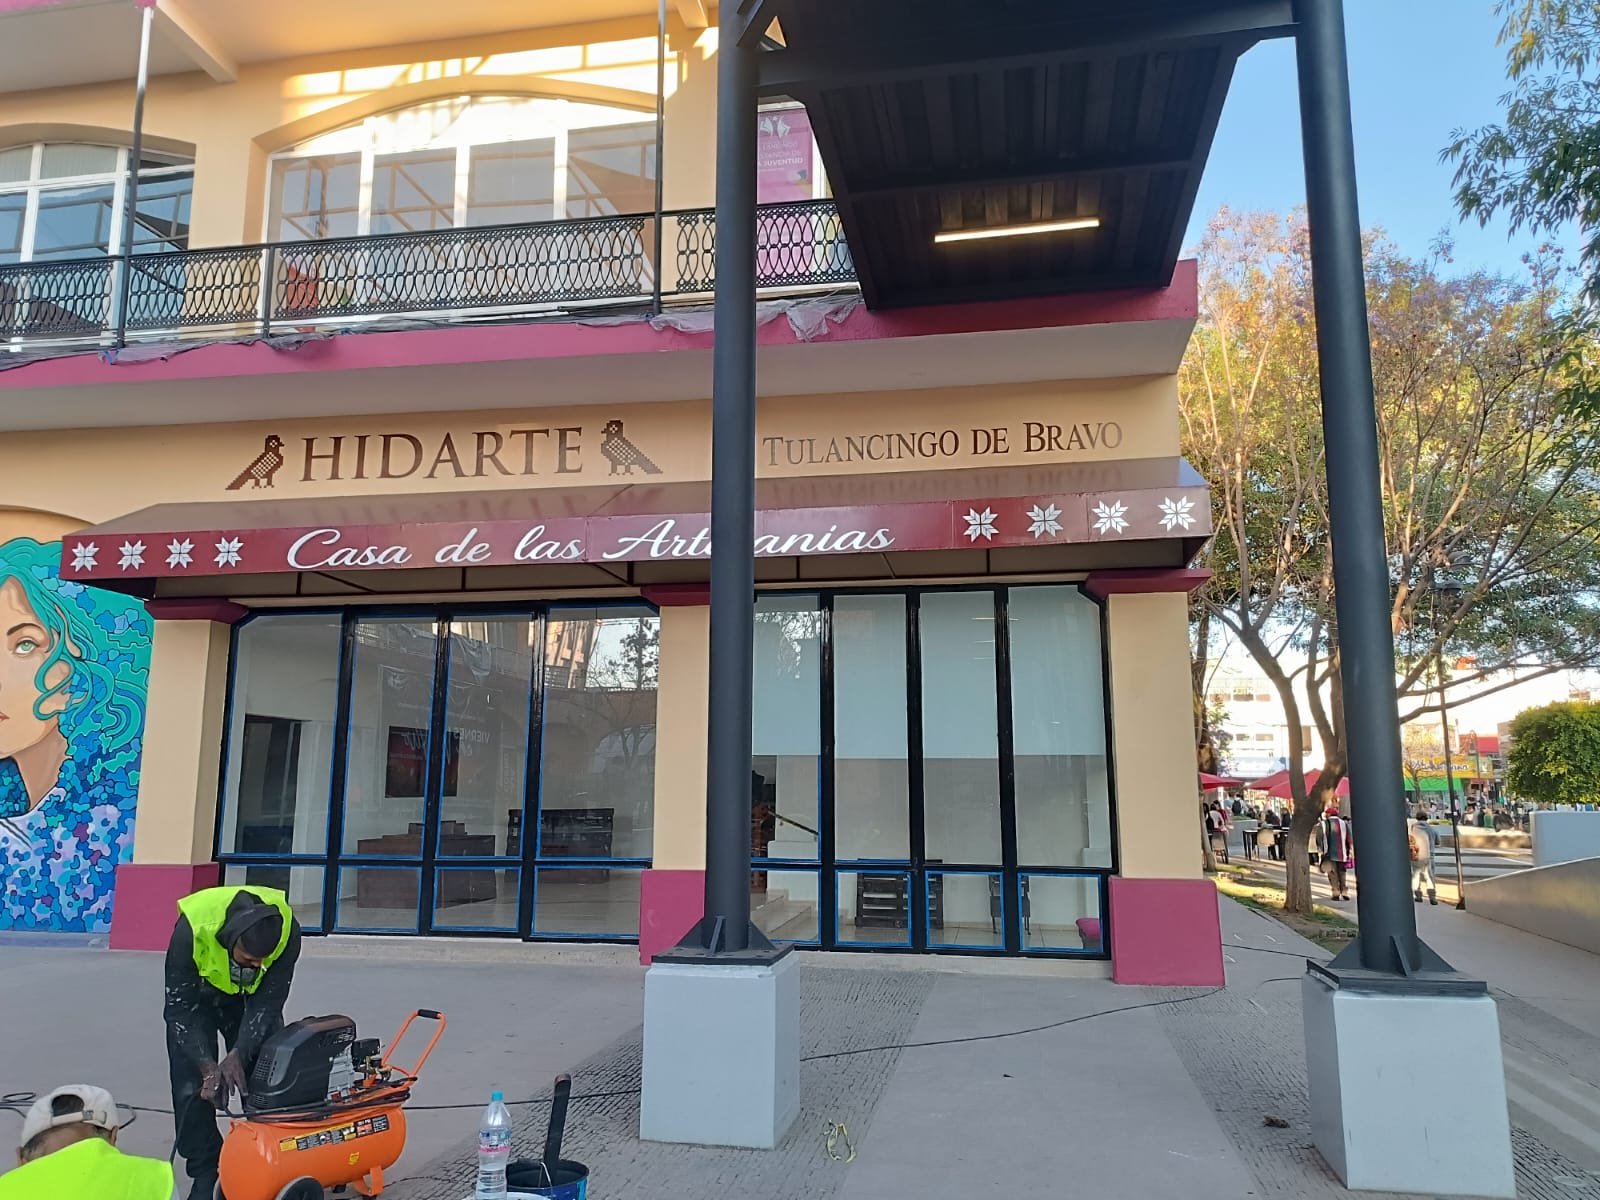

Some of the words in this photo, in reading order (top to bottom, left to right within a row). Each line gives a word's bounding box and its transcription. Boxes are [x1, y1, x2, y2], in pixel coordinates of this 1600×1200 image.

[300, 427, 583, 481] HIDARTE
[763, 429, 960, 466] TULANCINGO
[971, 427, 1010, 455] DE
[1023, 421, 1123, 453] BRAVO
[287, 528, 413, 569] Casa
[435, 527, 492, 563] de
[514, 524, 585, 562] las
[602, 519, 896, 560] Artanias
